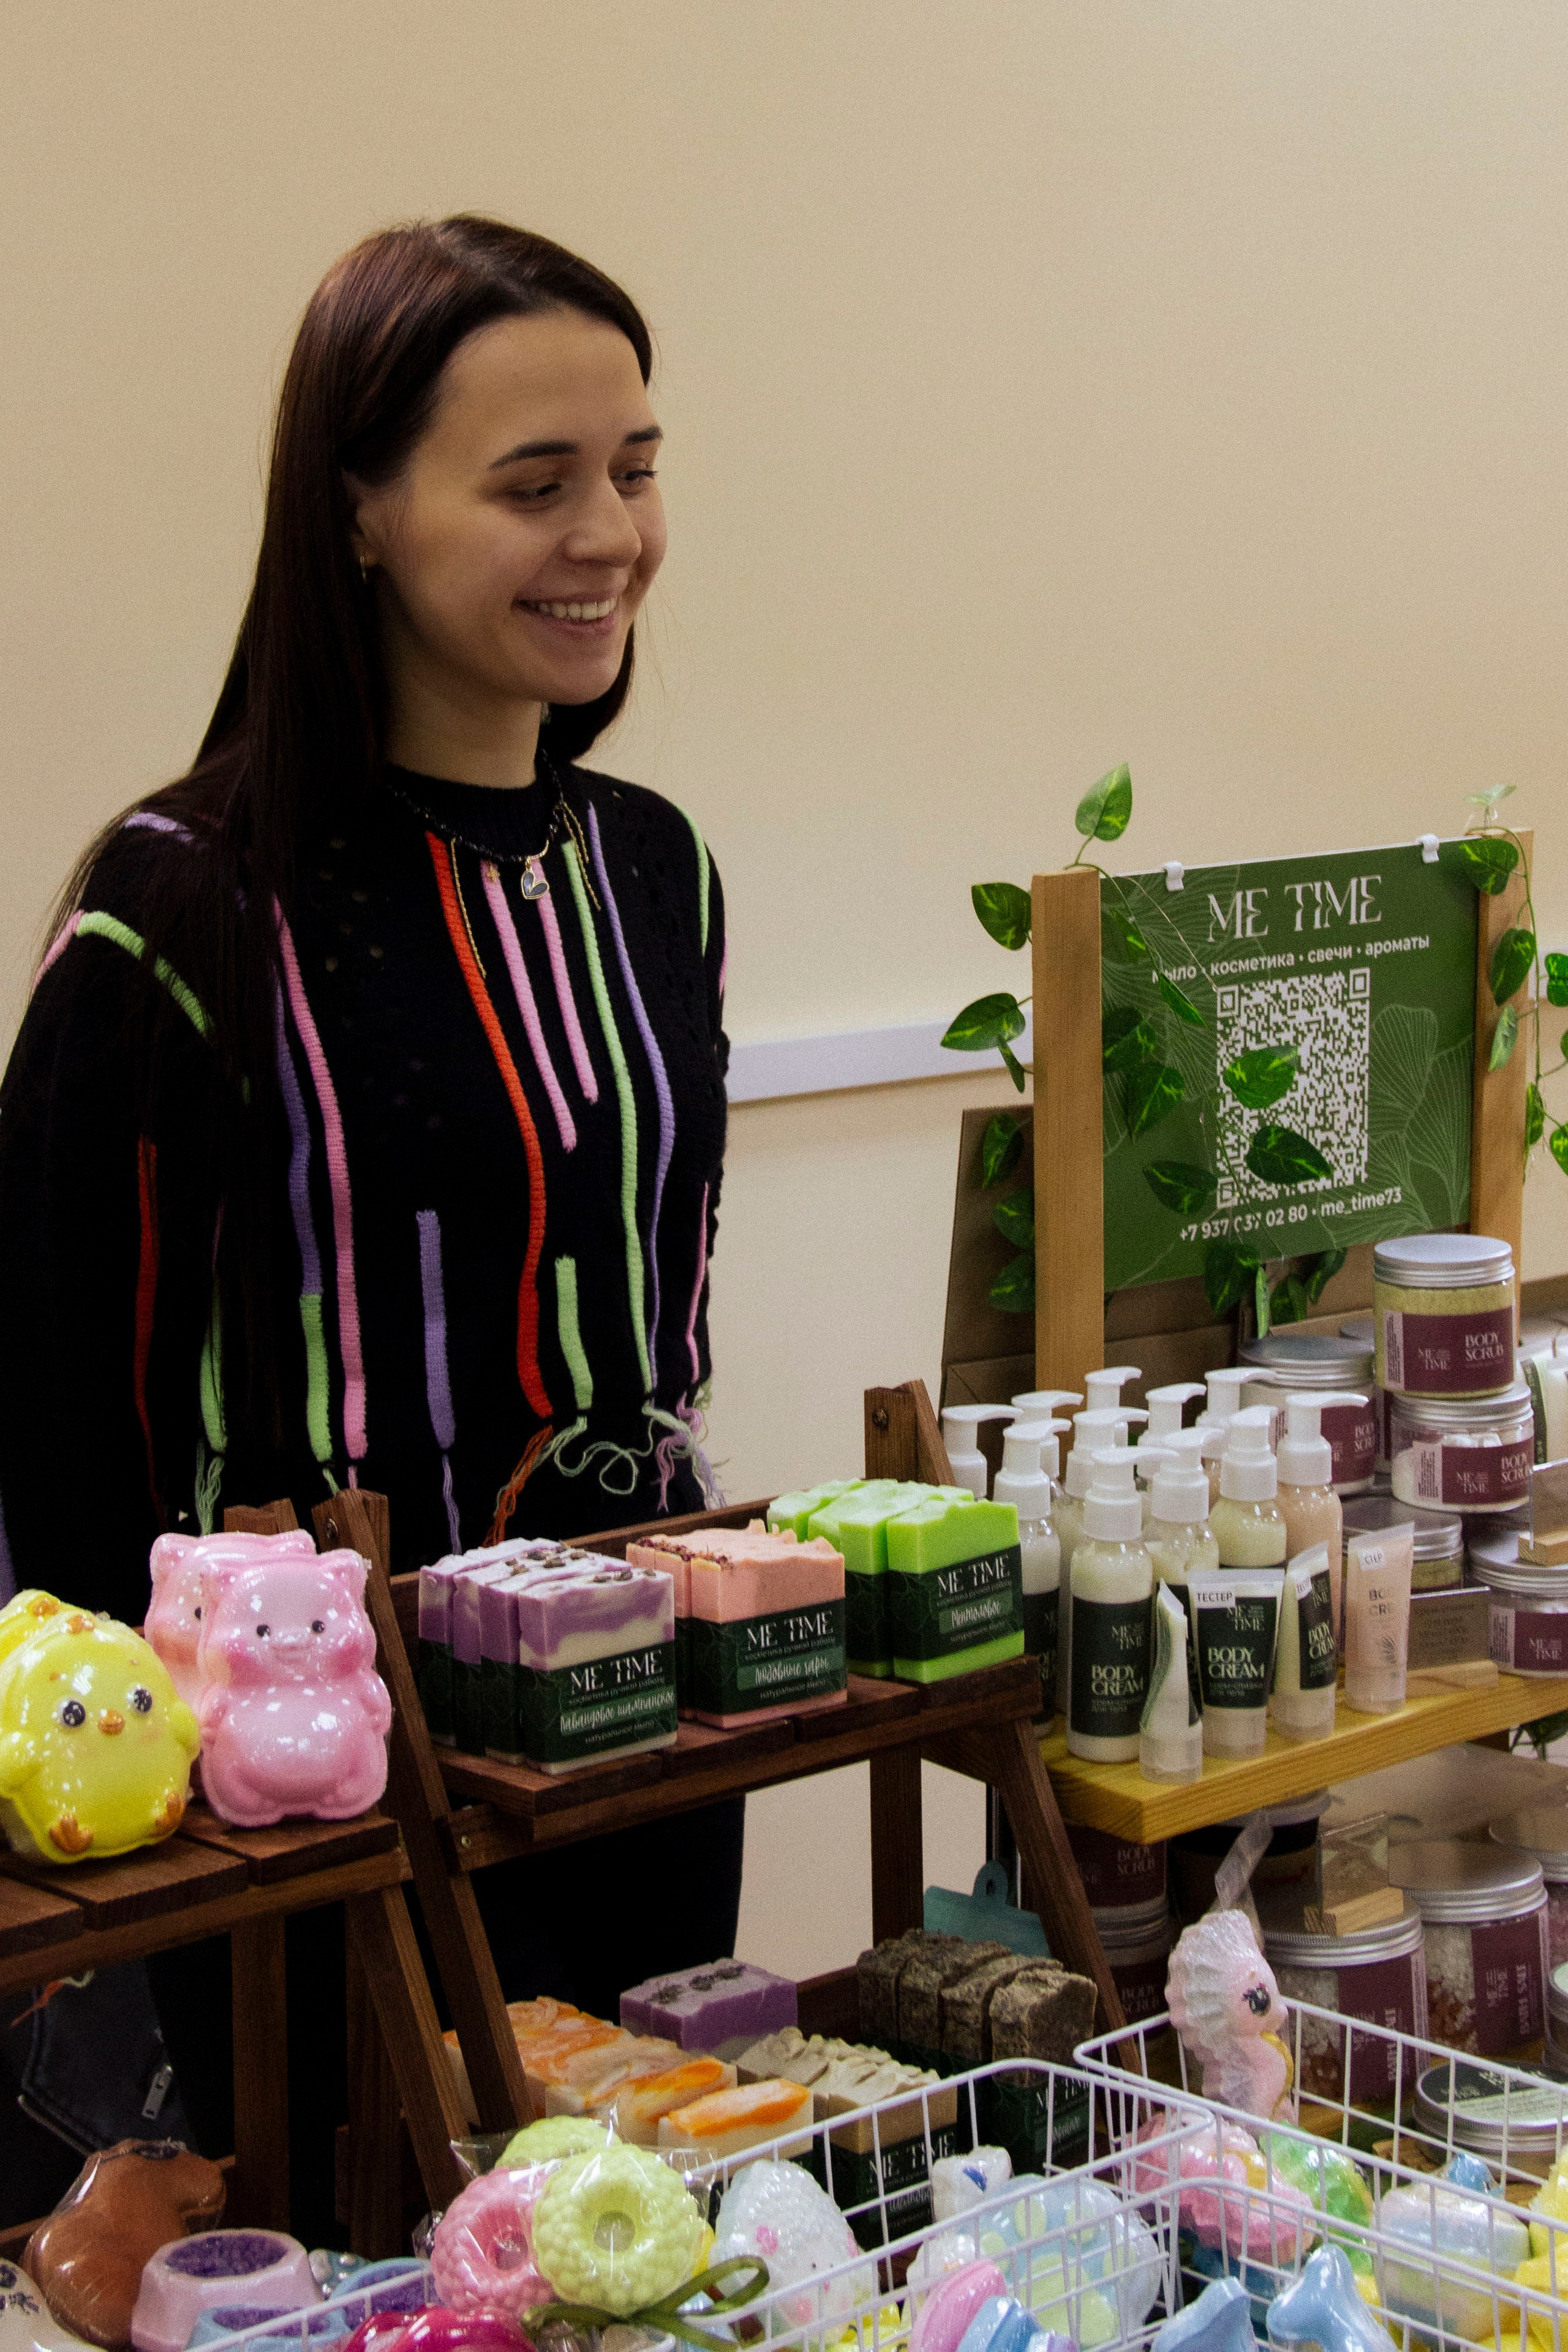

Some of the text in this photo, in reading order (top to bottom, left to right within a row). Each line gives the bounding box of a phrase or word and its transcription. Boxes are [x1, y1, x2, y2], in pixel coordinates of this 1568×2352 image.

[1207, 875, 1382, 942] ME TIME
[1210, 952, 1295, 976] косметика
[1307, 946, 1352, 963] свечи
[1365, 935, 1430, 960] ароматы
[1180, 1225, 1197, 1241] +7
[1202, 1218, 1229, 1239] 937
[1266, 1209, 1285, 1226] 02
[1288, 1204, 1308, 1221] 80
[1321, 1186, 1403, 1218] me_time73
[1465, 1332, 1499, 1348] BODY
[1465, 1344, 1504, 1362] SCRUB
[938, 1554, 1010, 1597] ME TIME
[1197, 1593, 1233, 1602] ТЕСТЕР
[745, 1610, 834, 1651] ME TIME
[1208, 1646, 1254, 1662] BODY
[570, 1649, 663, 1695] ME TIME
[1092, 1664, 1136, 1681] BODY
[1208, 1662, 1265, 1678] CREAM
[1091, 1676, 1144, 1695] CREAM
